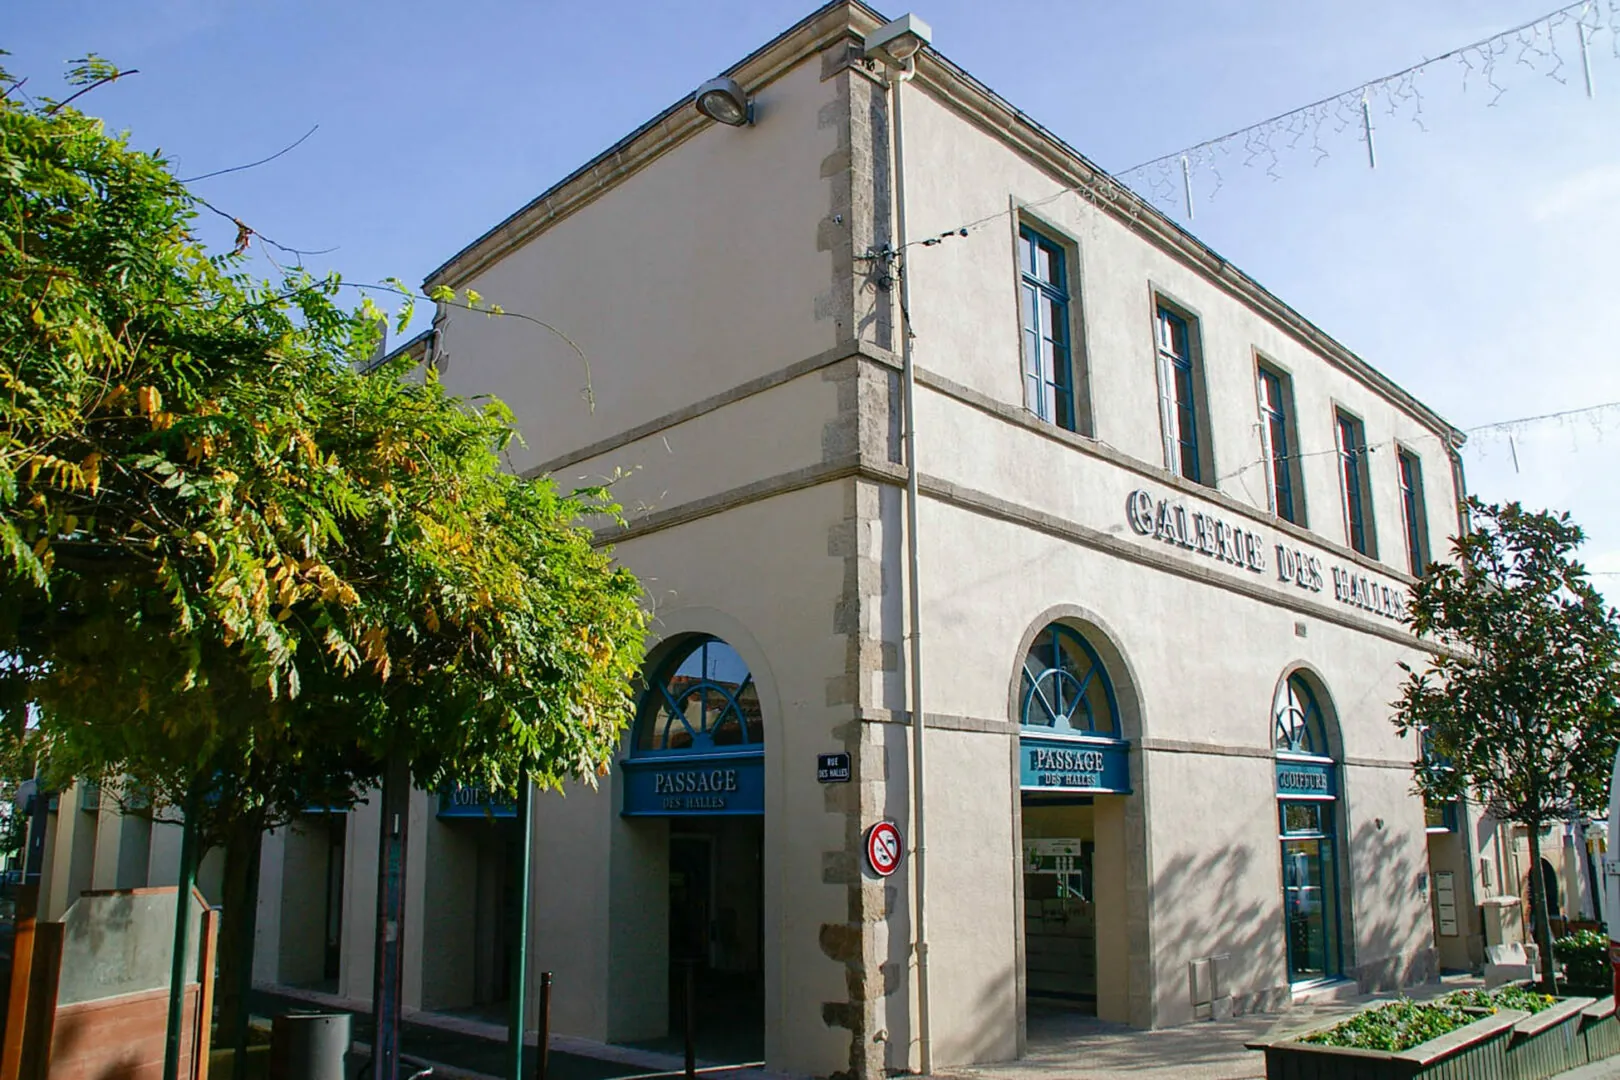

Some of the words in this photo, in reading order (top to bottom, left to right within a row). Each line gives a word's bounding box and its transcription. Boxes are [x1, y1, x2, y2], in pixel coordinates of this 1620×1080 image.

[1127, 488, 1266, 573] GALERIE
[1277, 543, 1323, 592] DES
[1332, 566, 1410, 621] HALLES
[827, 757, 838, 767] RUE
[1036, 748, 1104, 772] PASSAGE
[819, 769, 828, 778] DES
[830, 767, 848, 777] HALLES
[1045, 772, 1062, 786] DES
[1065, 773, 1096, 786] HALLES
[1283, 771, 1328, 789] COIFFURE
[655, 769, 737, 793] PASSAGE
[663, 796, 680, 809] DES
[686, 796, 724, 809] HALLES
